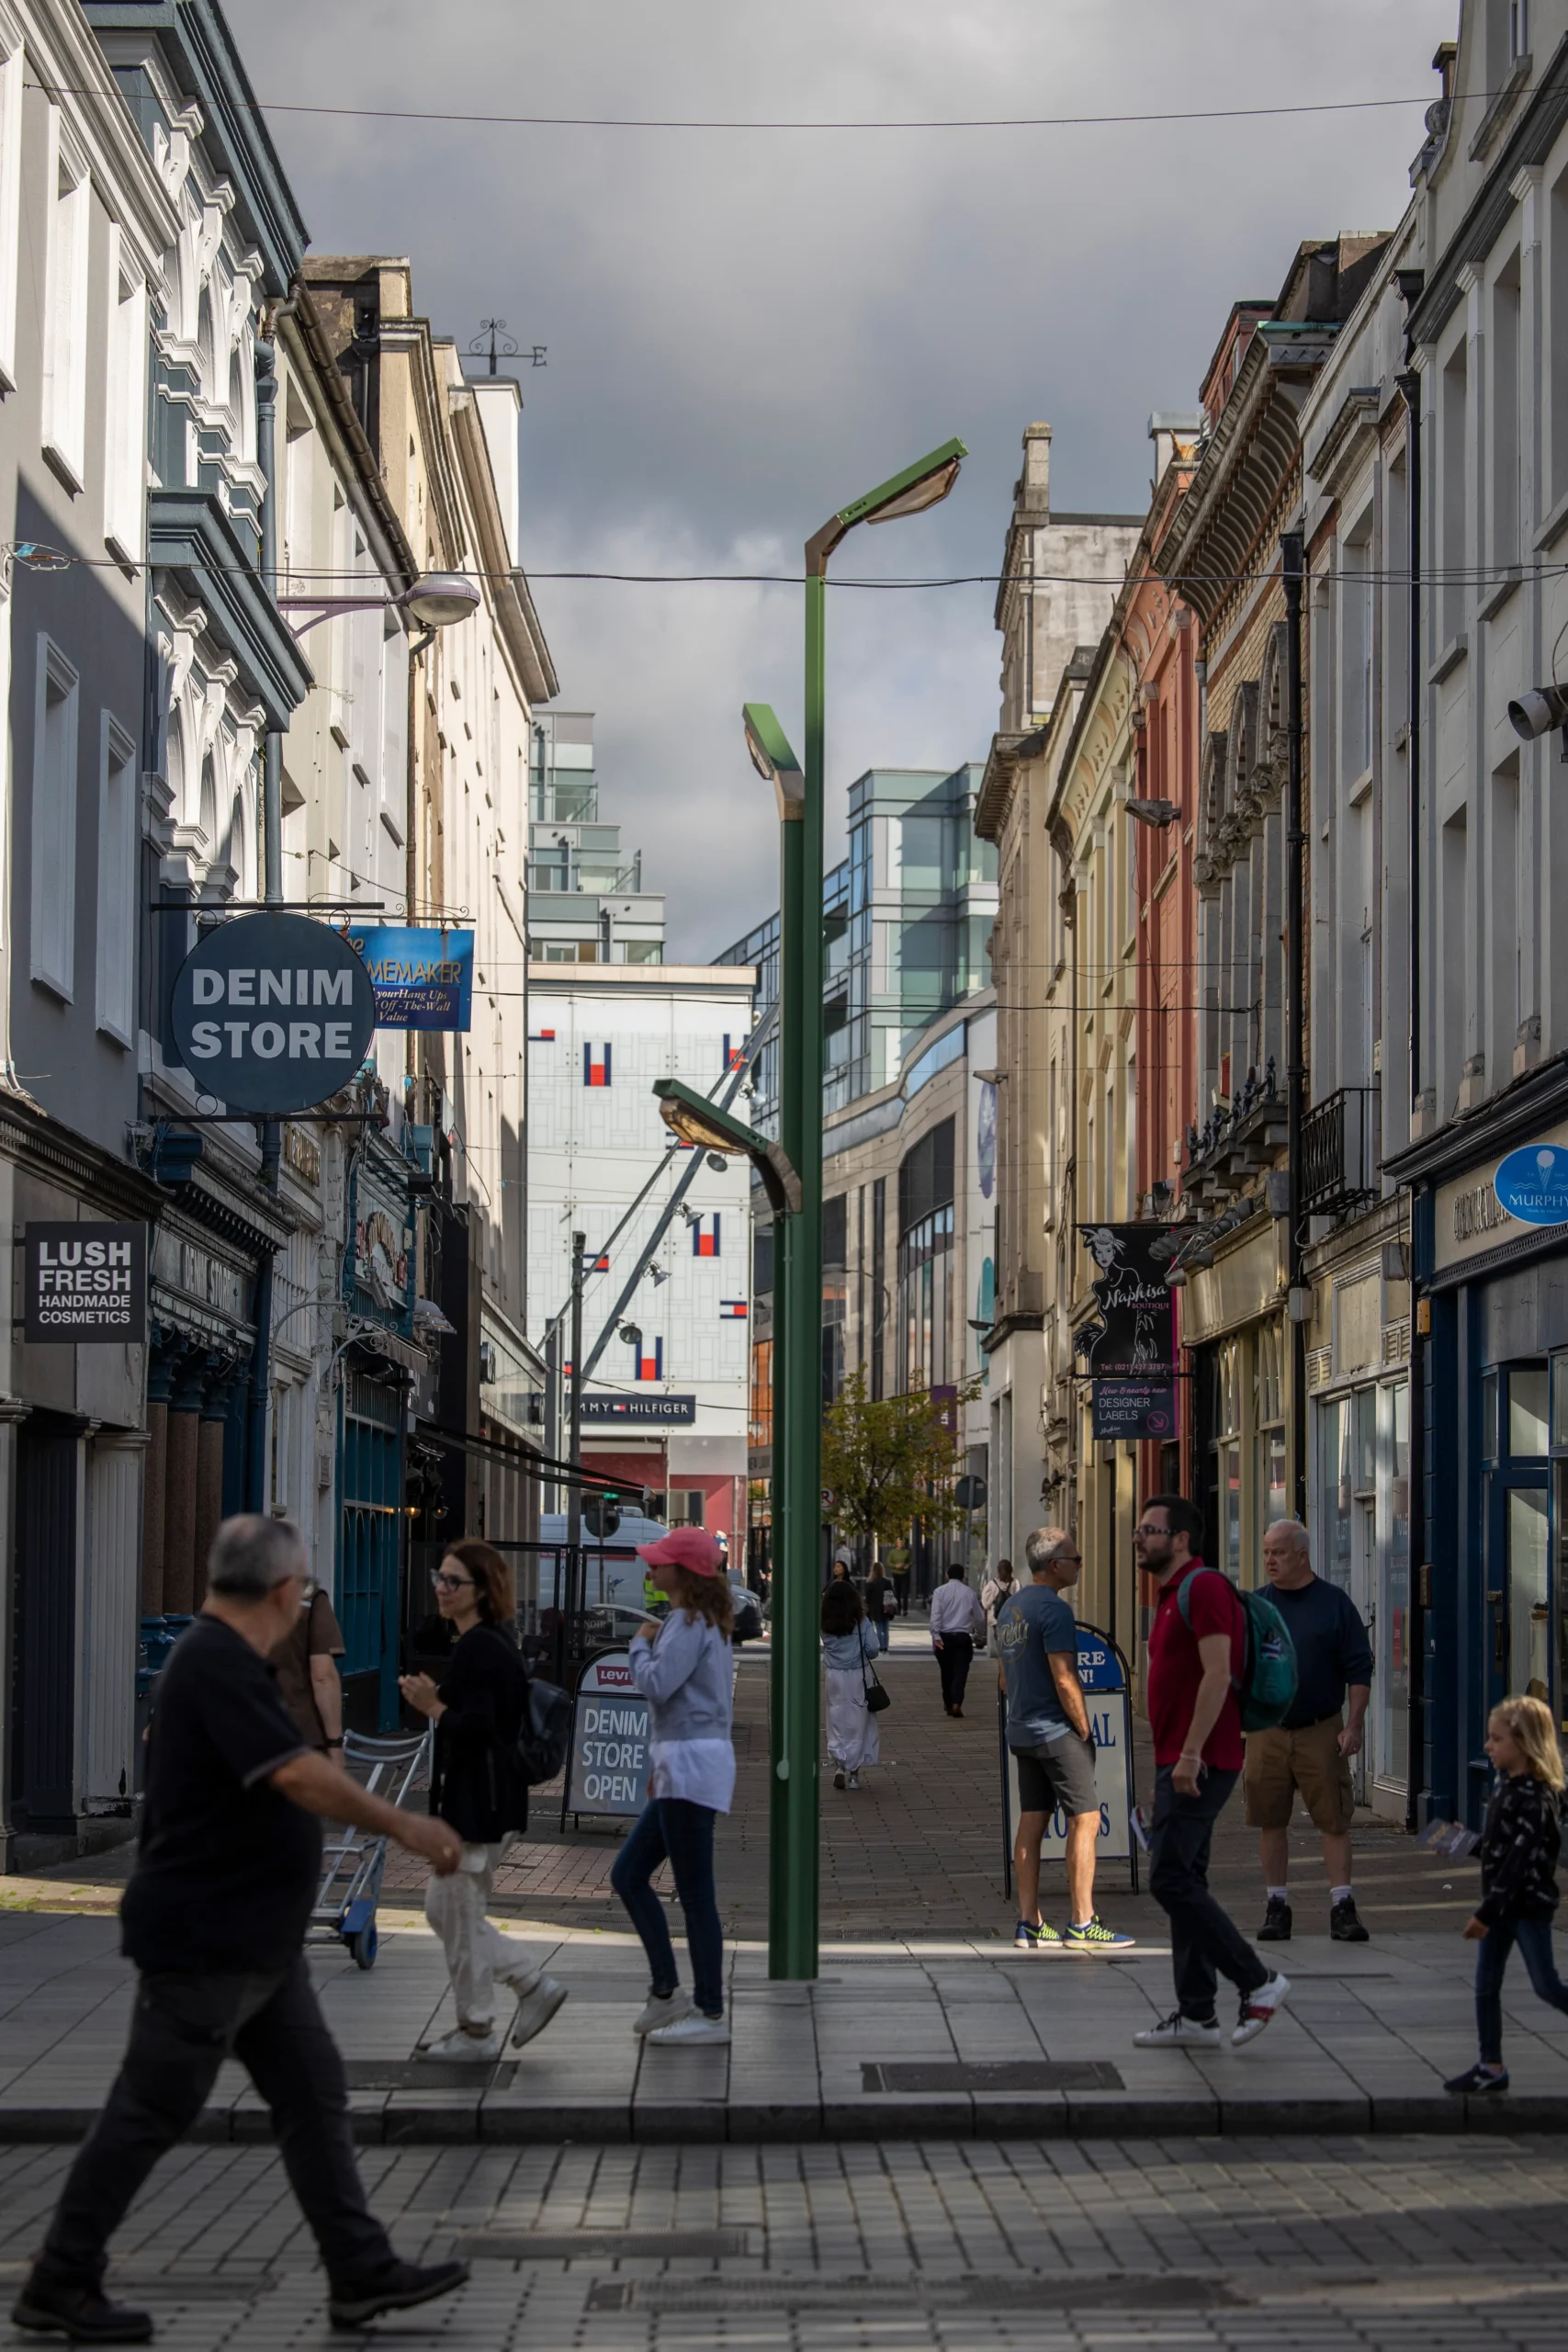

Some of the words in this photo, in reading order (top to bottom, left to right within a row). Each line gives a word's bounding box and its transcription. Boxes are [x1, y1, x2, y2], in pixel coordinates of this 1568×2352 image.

[193, 969, 353, 1005] DENIM
[430, 989, 447, 1002] Ups
[379, 1012, 409, 1022] Value
[190, 1022, 352, 1058] STORE
[39, 1241, 130, 1266] LUSH
[39, 1270, 130, 1291] FRESH
[39, 1295, 130, 1307] HANDMADE
[1102, 1283, 1168, 1309] Naphisa
[39, 1311, 130, 1323] COSMETICS
[1100, 1386, 1118, 1396] New
[1126, 1386, 1150, 1395] nearly
[629, 1403, 688, 1414] HILFIGER
[1099, 1397, 1151, 1408] DESIGNER
[1099, 1410, 1139, 1420] LABELS
[584, 1708, 648, 1736] DENIM
[582, 1741, 644, 1770] STORE
[584, 1774, 637, 1802] OPEN
